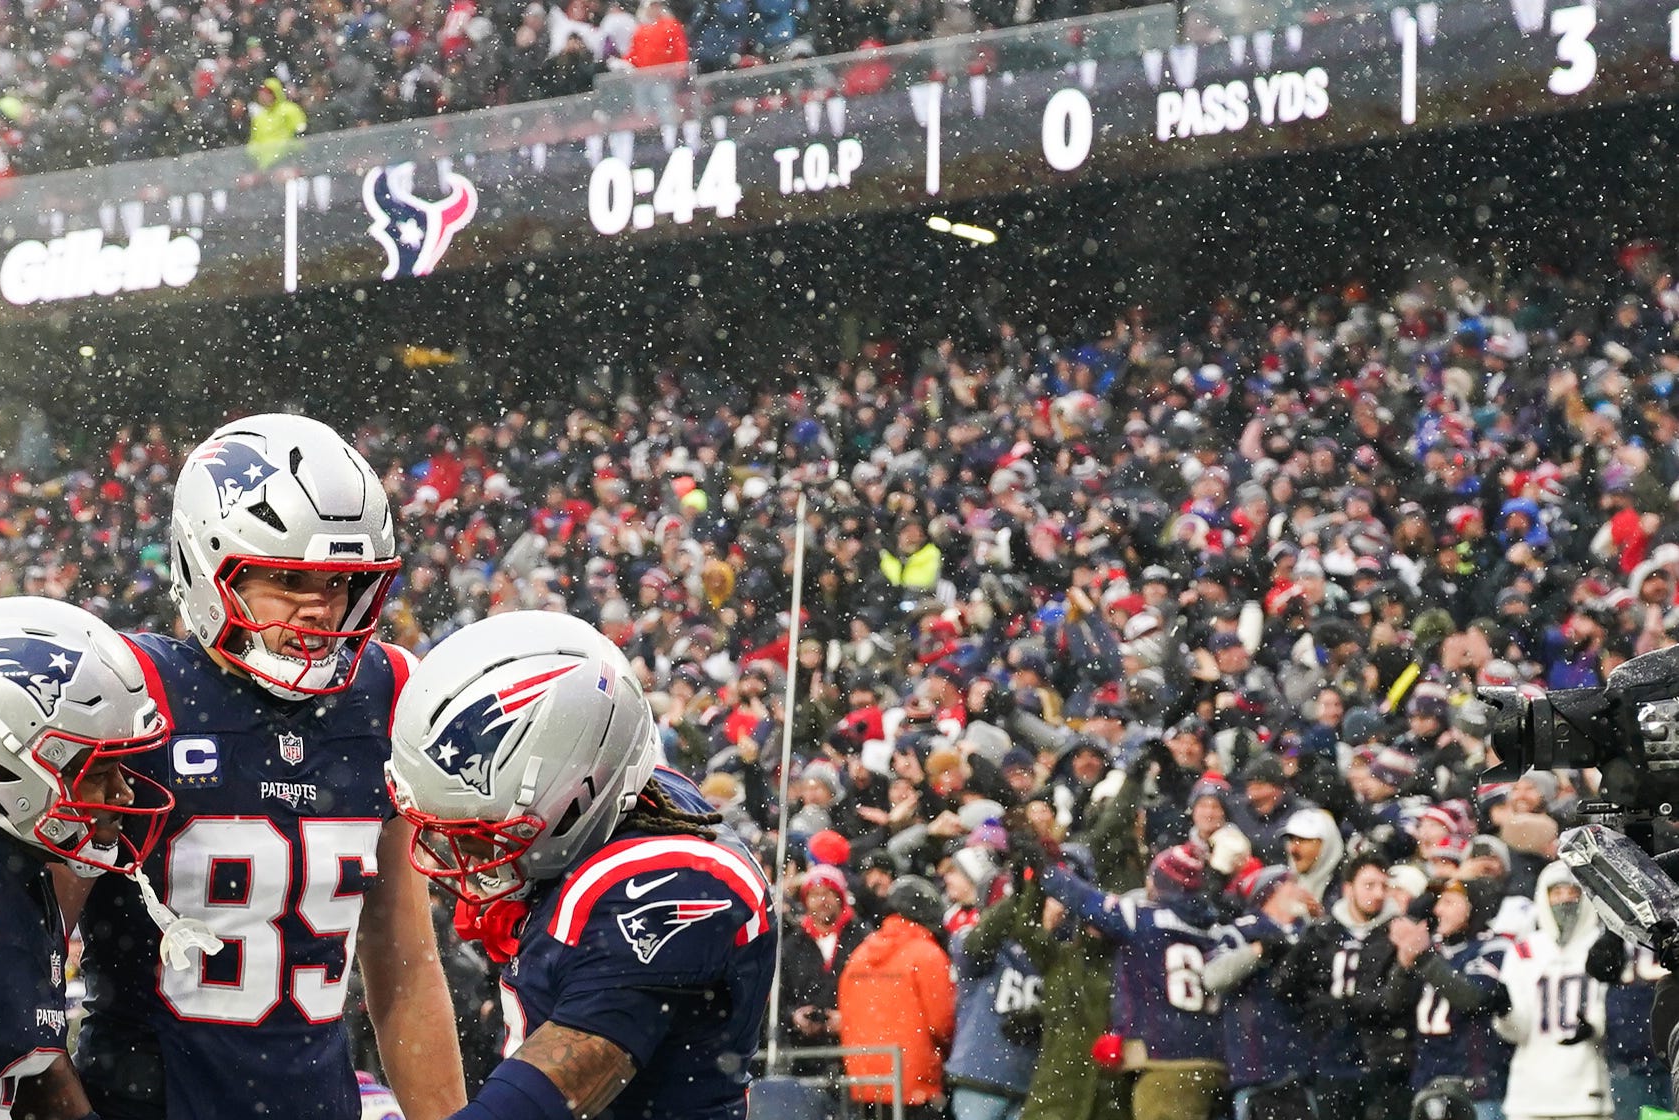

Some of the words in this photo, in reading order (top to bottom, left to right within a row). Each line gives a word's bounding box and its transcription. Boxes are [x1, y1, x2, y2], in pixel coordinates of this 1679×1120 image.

[1547, 4, 1597, 95] 3
[1042, 87, 1093, 171] 0
[1156, 79, 1249, 142] PASS
[1253, 66, 1330, 126] YDS
[588, 138, 742, 235] 0:44
[0, 224, 201, 305] Gillette
[172, 738, 218, 775] C
[261, 781, 317, 801] PATRIOTS
[284, 746, 301, 760] NFL
[155, 814, 383, 1027] 85
